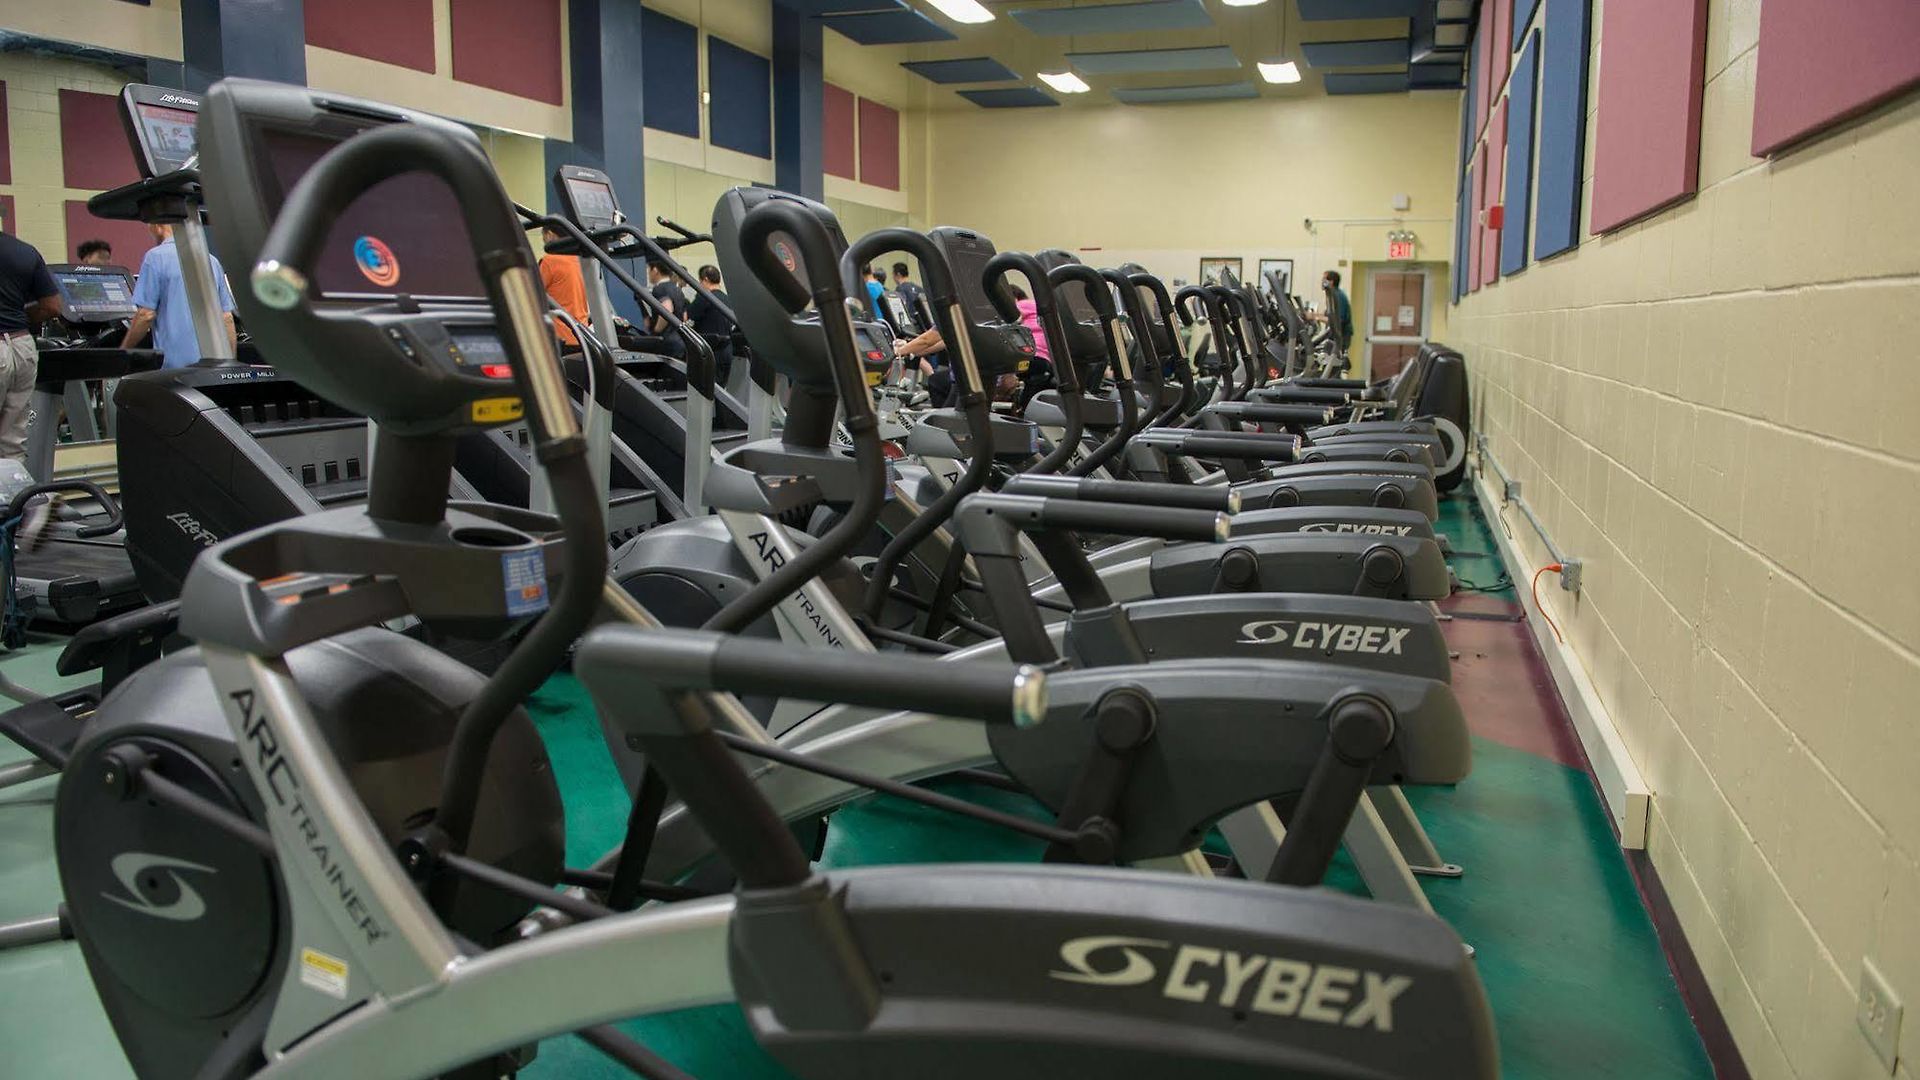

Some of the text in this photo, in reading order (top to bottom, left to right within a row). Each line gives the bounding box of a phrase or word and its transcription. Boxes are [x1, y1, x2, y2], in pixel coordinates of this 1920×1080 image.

[1391, 241, 1411, 257] EXIT
[1292, 621, 1411, 655] CYBEX
[1163, 944, 1414, 1033] CYBEX
